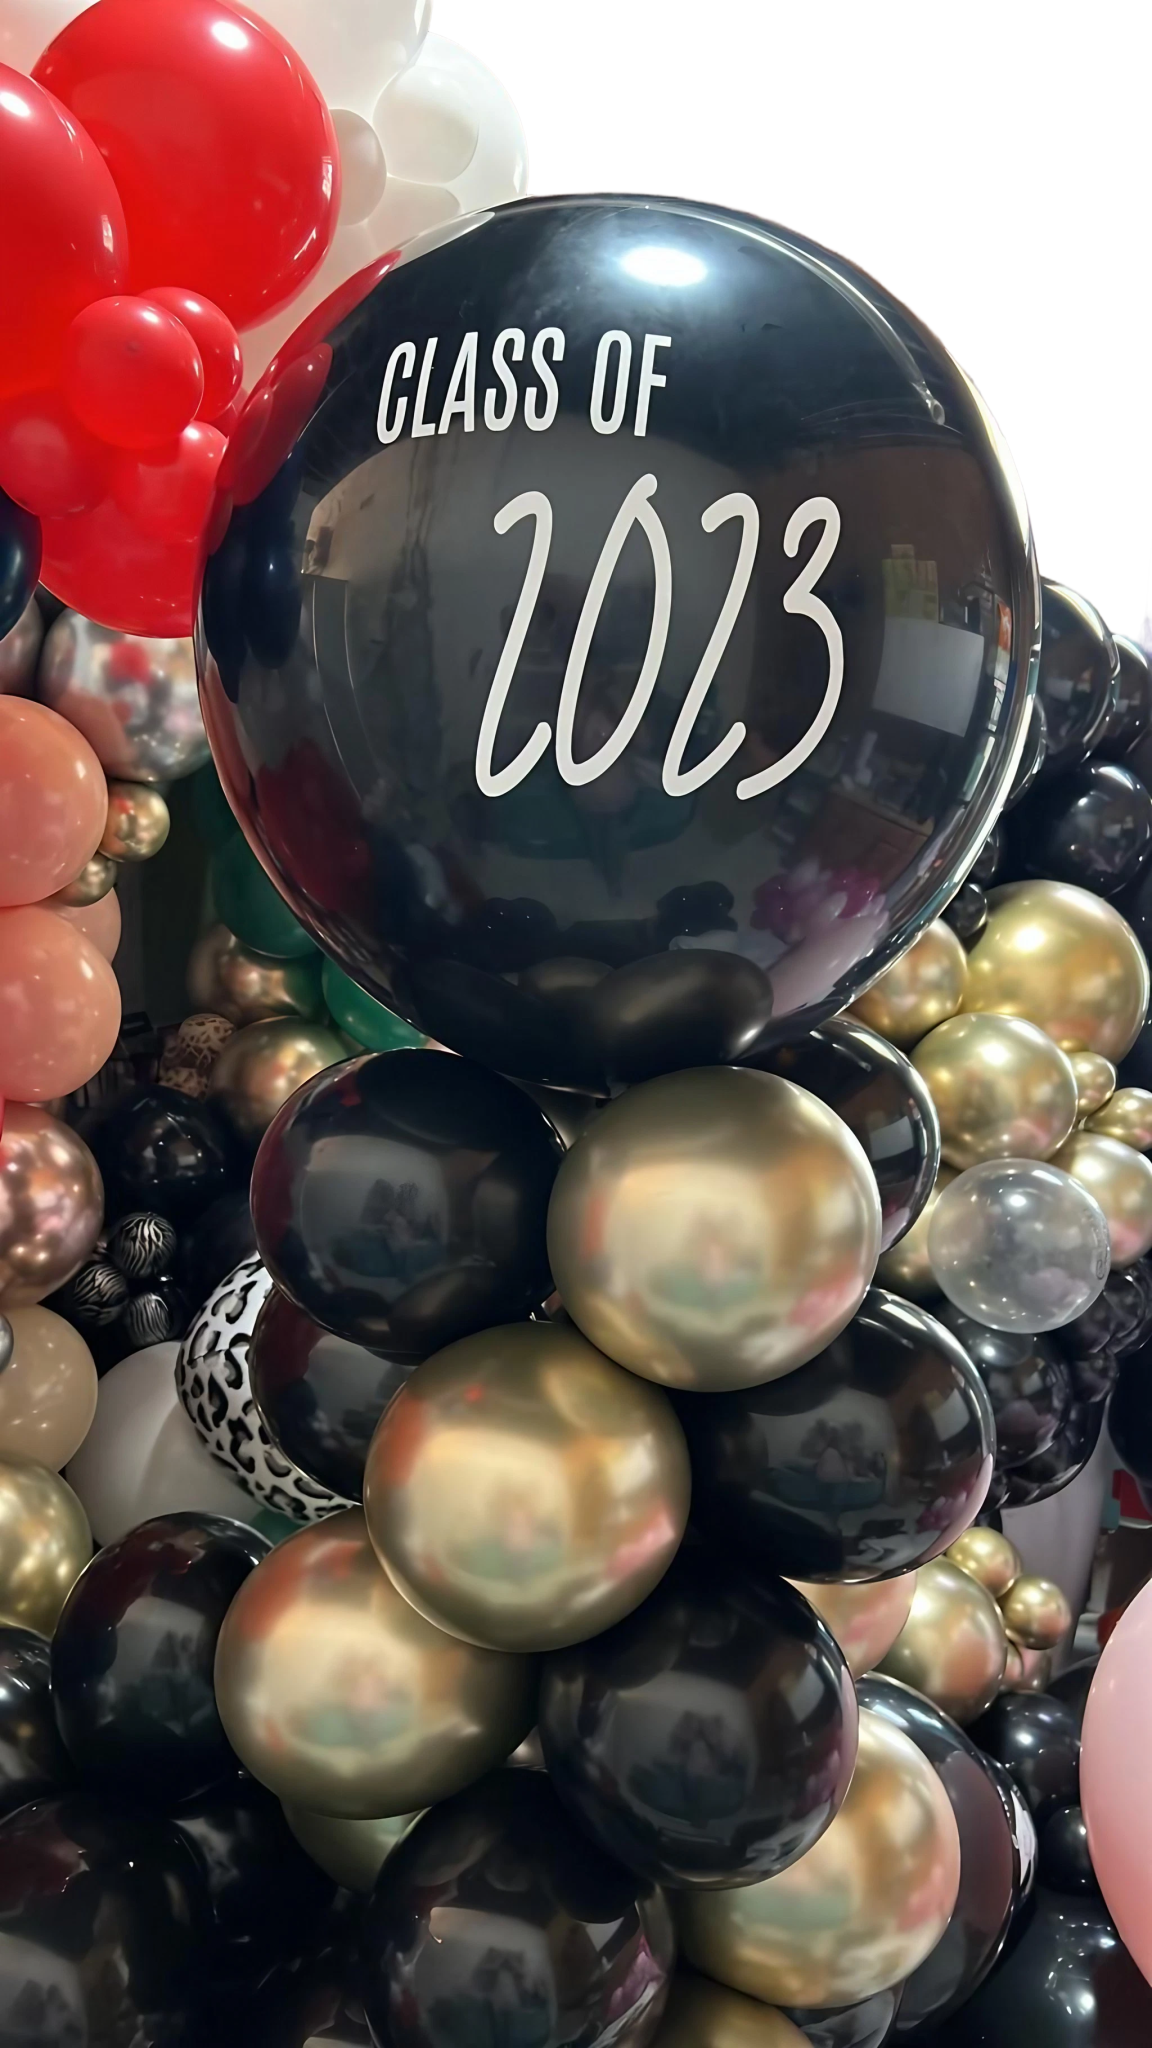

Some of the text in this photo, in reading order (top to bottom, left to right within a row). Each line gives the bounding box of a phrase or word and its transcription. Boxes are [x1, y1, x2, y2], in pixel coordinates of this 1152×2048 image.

[376, 326, 672, 445] CLASS OF
[475, 473, 844, 801] 2023
